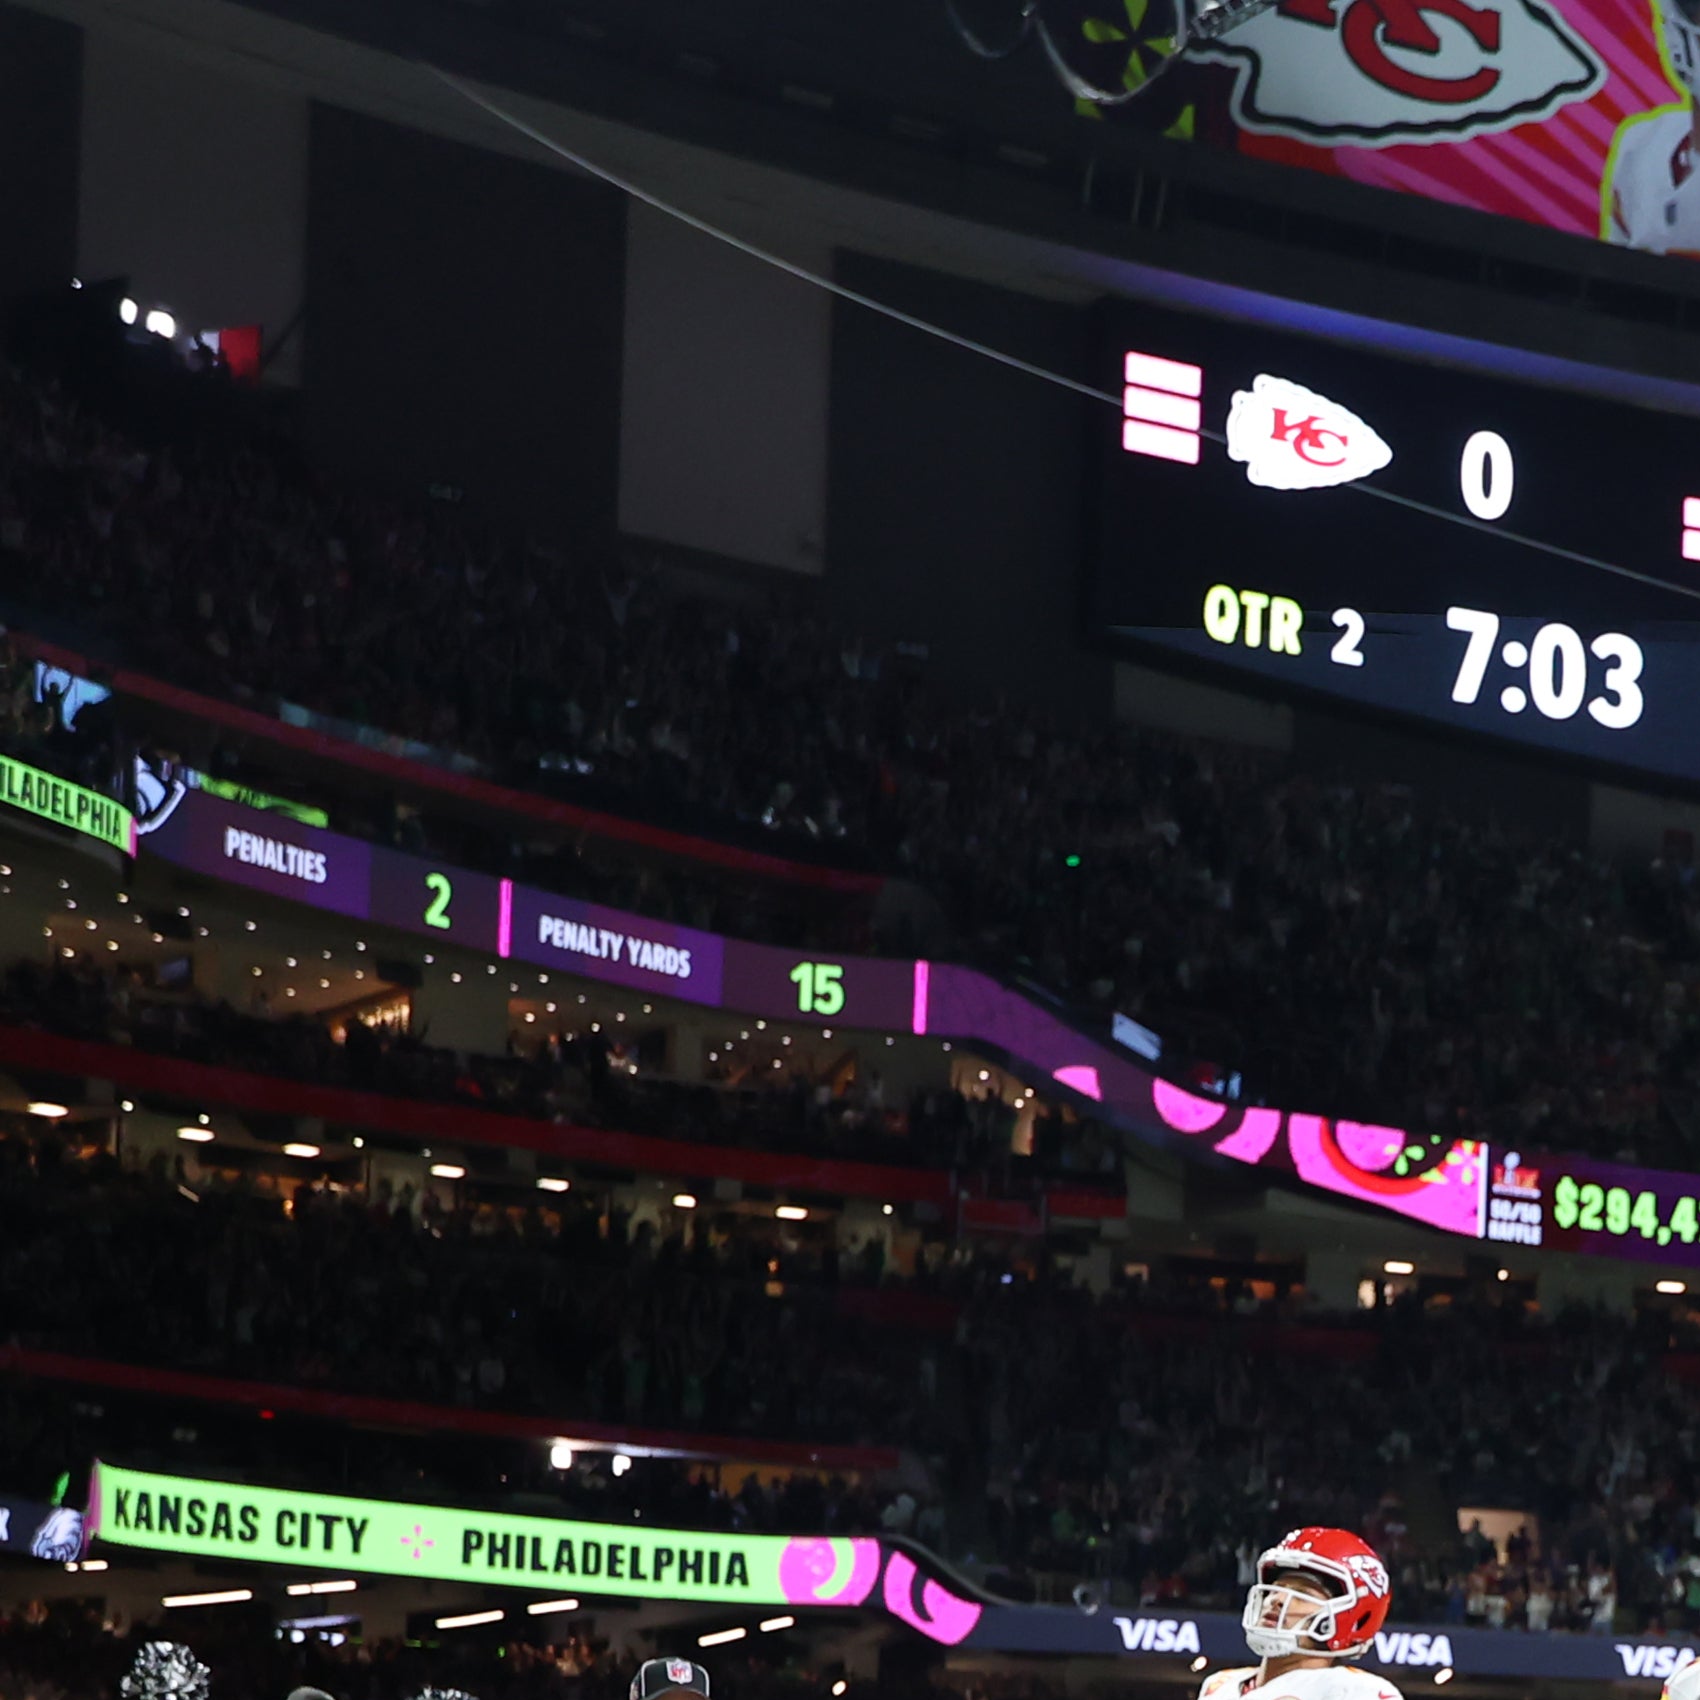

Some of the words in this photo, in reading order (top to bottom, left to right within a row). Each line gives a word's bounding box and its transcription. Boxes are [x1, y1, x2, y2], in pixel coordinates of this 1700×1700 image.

[1270, 407, 1348, 467] KC
[1461, 431, 1513, 519] 0
[1204, 585, 1302, 654] QTR
[1331, 609, 1364, 666] 2
[1447, 607, 1643, 728] 7:03
[225, 826, 326, 883] PENALTIES
[425, 873, 451, 928] 2
[539, 914, 624, 962] PENALTY
[627, 937, 691, 978] YARDS
[790, 962, 844, 1015] 15
[115, 1488, 260, 1542] KANSAS
[275, 1509, 369, 1553] CITY
[461, 1529, 749, 1586] PHILADELPHIA
[1113, 1617, 1200, 1654] VISA
[1374, 1631, 1454, 1666] VISA
[1615, 1644, 1696, 1678] VISA
